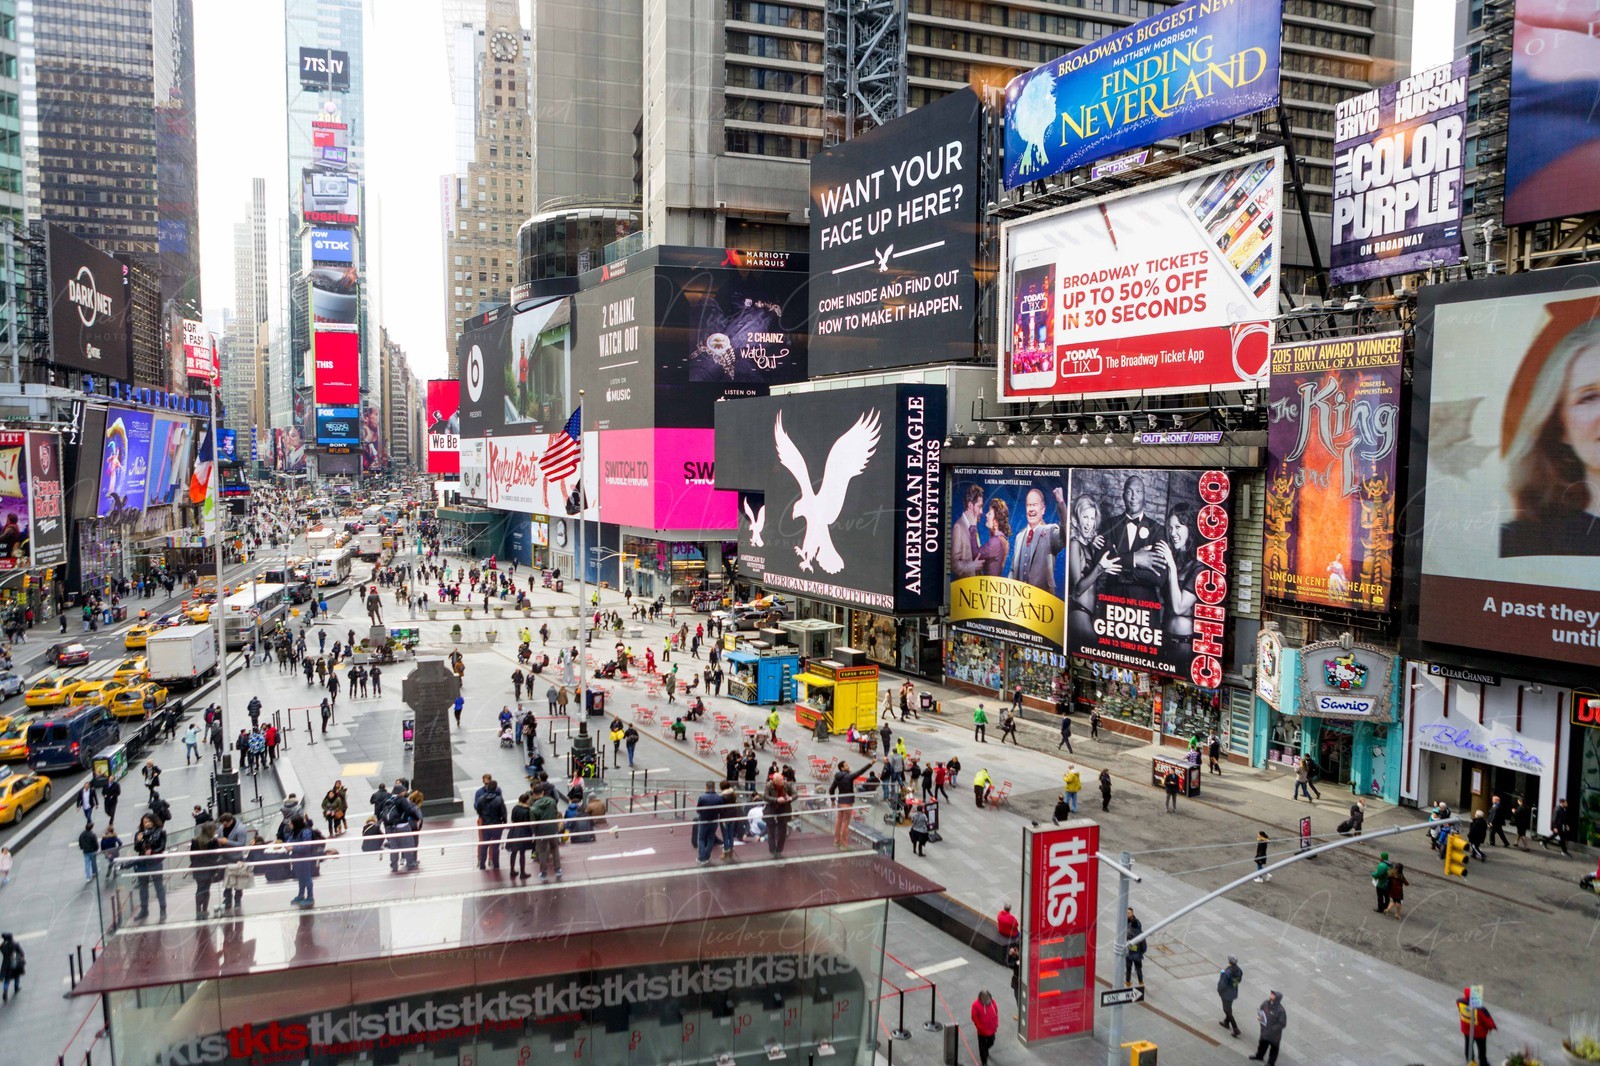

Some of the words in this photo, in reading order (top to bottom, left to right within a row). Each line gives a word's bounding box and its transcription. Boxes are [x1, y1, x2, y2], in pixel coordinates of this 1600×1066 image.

[1058, 31, 1134, 77] BROADWAY'S
[1137, 7, 1196, 43] BIGGEST
[1198, 0, 1237, 15] NEW
[1113, 43, 1151, 67] MATTHEW
[1153, 26, 1198, 51] MORRISON
[1101, 34, 1214, 99] FINDING
[1396, 63, 1453, 100] JENNIFER
[1060, 46, 1268, 148] NEVERLAND
[1336, 89, 1380, 120] CYNTHIA
[1394, 76, 1466, 125] HUDSON
[1336, 107, 1380, 144] ERIVO
[1352, 114, 1464, 194] COLOR
[820, 169, 885, 218] WANT
[891, 140, 963, 192] YOUR
[1335, 148, 1354, 199] THE
[304, 211, 358, 223] TOSHIBA
[820, 216, 863, 250] FACE
[867, 207, 892, 236] UP
[898, 184, 964, 227] HERE?
[1332, 168, 1461, 246] PURPLE
[323, 241, 350, 250] TDK
[746, 251, 790, 260] MARRIOTT
[1360, 244, 1372, 257] ON
[1374, 232, 1424, 254] BROADWAY
[746, 259, 785, 267] MARQUIS
[1063, 263, 1139, 289] BROADWAY
[1146, 250, 1209, 273] TICKETS
[818, 295, 844, 313] COME
[846, 288, 878, 307] INSIDE
[880, 282, 903, 300] AND
[905, 276, 931, 295] FIND
[934, 269, 960, 287] OUT
[1063, 291, 1086, 310] UP
[1090, 287, 1114, 305] TO
[1119, 277, 1160, 302] 50%
[1165, 269, 1209, 294] OFF
[602, 306, 607, 329] 2
[608, 297, 635, 328] CHAINZ
[818, 317, 843, 335] HOW
[845, 315, 859, 330] TO
[861, 308, 892, 328] MAKE
[895, 306, 906, 322] IT
[908, 294, 963, 319] HAPPEN.
[1028, 300, 1041, 311] TIX
[1062, 311, 1080, 331] IN
[1084, 307, 1107, 327] 30
[1111, 293, 1207, 324] SECONDS
[598, 331, 622, 358] WATCH
[624, 326, 639, 351] OUT
[747, 332, 754, 343] 2
[754, 332, 784, 344] CHAINZ
[1065, 347, 1100, 362] TODAY
[1105, 355, 1120, 369] The
[1120, 348, 1159, 369] Broadway
[1160, 349, 1187, 365] Ticket
[1188, 348, 1205, 364] App
[1272, 347, 1292, 364] 2015
[1293, 345, 1316, 361] TONY
[1317, 341, 1354, 359] AWARD
[1356, 337, 1402, 356] WINNER!
[316, 361, 334, 369] THIS
[1072, 359, 1091, 373] TIX
[1272, 363, 1293, 374] BEST
[1293, 359, 1333, 372] REVIVAL
[1333, 358, 1346, 369] OF
[1346, 357, 1354, 367] A
[1356, 354, 1400, 367] MUSICAL
[612, 388, 631, 402] MUSIC
[317, 408, 335, 417] FOX
[1270, 396, 1299, 424] The
[1286, 376, 1400, 463] King
[431, 437, 445, 450] We
[447, 437, 458, 450] Be
[907, 396, 924, 469] EAGLE
[1193, 433, 1219, 442] PRIME
[489, 441, 513, 503] Kinky
[513, 450, 539, 487] Boots
[604, 461, 635, 479] SWITCH
[637, 461, 649, 479] TO
[1293, 461, 1334, 494] and
[1339, 437, 1362, 500] I
[33, 476, 60, 497] SCHOOL
[925, 439, 941, 553] OUTFITTERS
[35, 497, 60, 519] ROCK
[905, 474, 923, 596] AMERICAN
[978, 579, 1032, 600] FINDING
[1190, 470, 1231, 690] CHICAGO
[1269, 570, 1303, 585] LINCOLN
[763, 573, 806, 592] AMERICAN
[806, 581, 834, 596] EAGLE
[834, 587, 894, 609] OUTFITTERS
[1097, 593, 1126, 604] STARRING
[1126, 598, 1138, 606] NFL
[1138, 600, 1162, 610] LEGEND
[959, 588, 1055, 624] NEVERLAND
[1106, 604, 1150, 627] EDDIE
[1483, 597, 1497, 612] A
[1501, 600, 1546, 618] past
[1550, 603, 1600, 628] they
[966, 621, 996, 633] BROADWAY'S
[995, 627, 1019, 638] SOARING
[1018, 632, 1031, 640] NEW
[1031, 635, 1043, 644] HIT!
[1093, 618, 1163, 646] GEORGE
[1098, 637, 1111, 645] JAN
[1112, 639, 1119, 647] 12
[1120, 641, 1137, 650] THRU
[1137, 644, 1148, 653] FEB
[1024, 647, 1067, 669] GRAND
[1080, 646, 1176, 673] CHICAGOTHEMUSICAL.COM
[1092, 662, 1134, 685] SLAM
[1320, 697, 1369, 712] Sanrio
[1419, 724, 1491, 755] Blue
[1490, 738, 1547, 768] Fin
[1419, 741, 1448, 752] SEAFOOD
[1467, 751, 1488, 760] SUSHI
[1047, 835, 1088, 927] tkts
[835, 999, 849, 1014] 12
[1107, 994, 1120, 1003] ONE
[1125, 990, 1139, 1001] WAY
[737, 1013, 753, 1027] 10
[787, 1007, 799, 1020] 11
[631, 1030, 642, 1044] 8
[685, 1022, 695, 1035] 9
[520, 1045, 532, 1059] 6
[577, 1037, 586, 1051] 7
[462, 1054, 474, 1066] 5
